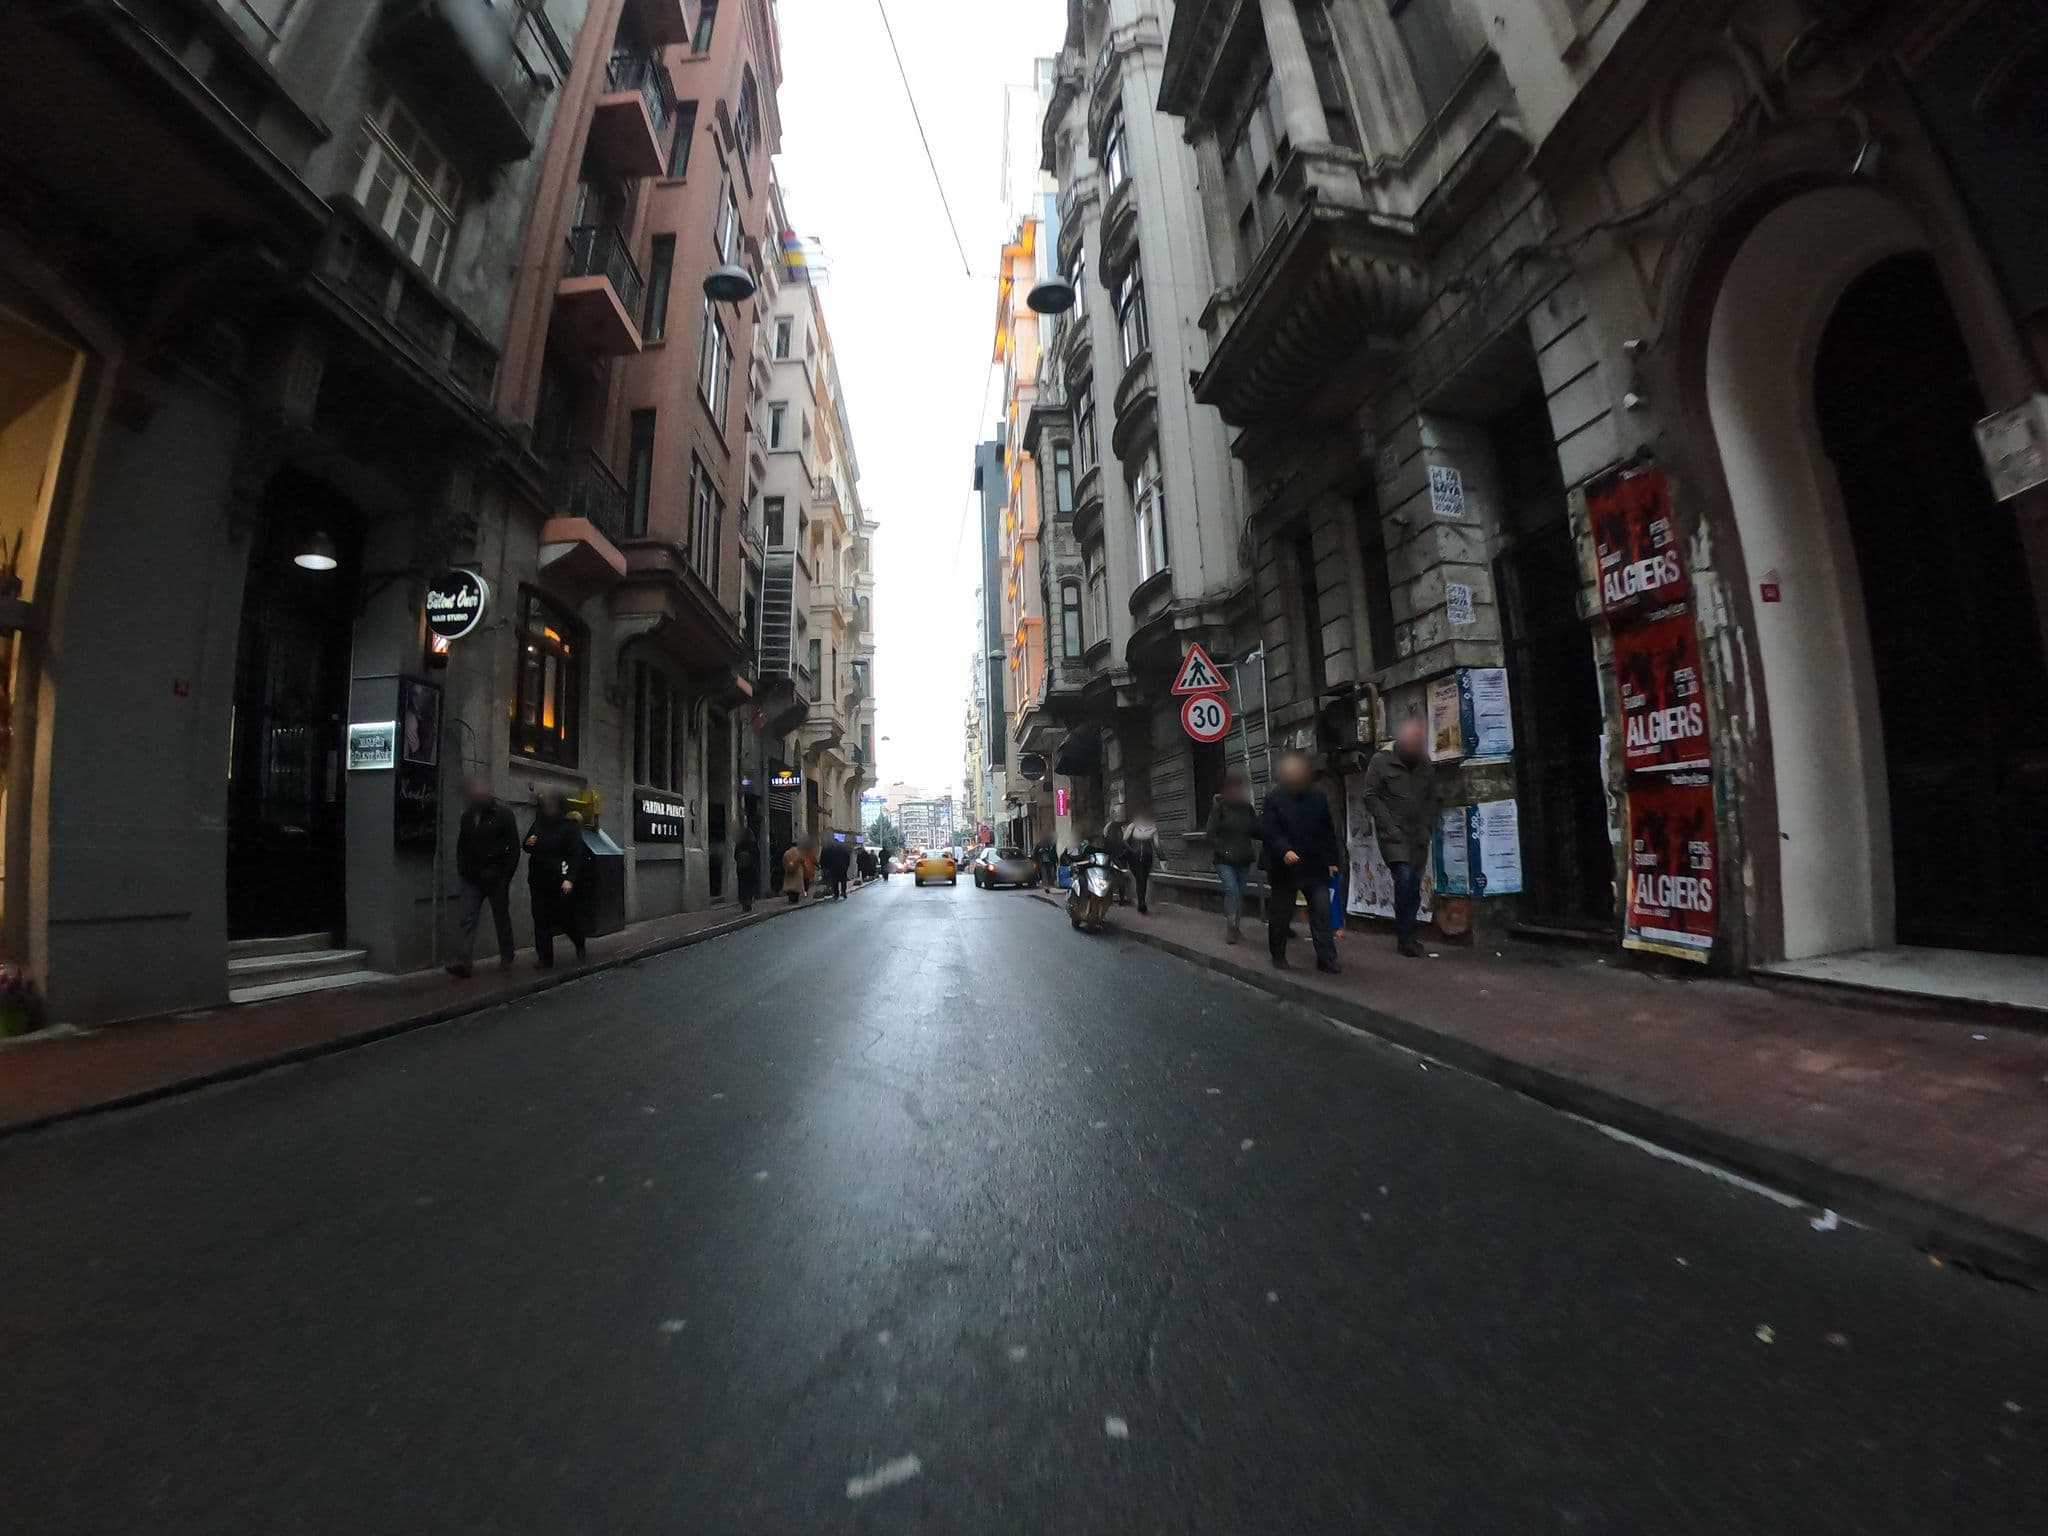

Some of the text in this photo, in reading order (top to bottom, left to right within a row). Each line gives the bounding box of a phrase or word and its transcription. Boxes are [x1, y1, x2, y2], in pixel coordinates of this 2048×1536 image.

[1603, 550, 1681, 603] ALGIERS
[446, 613, 468, 622] STUDIO
[1192, 705, 1220, 729] 30
[1627, 702, 1703, 748] ALGIERS
[651, 822, 677, 836] HOTEL
[1635, 873, 1712, 913] ALGIERS
